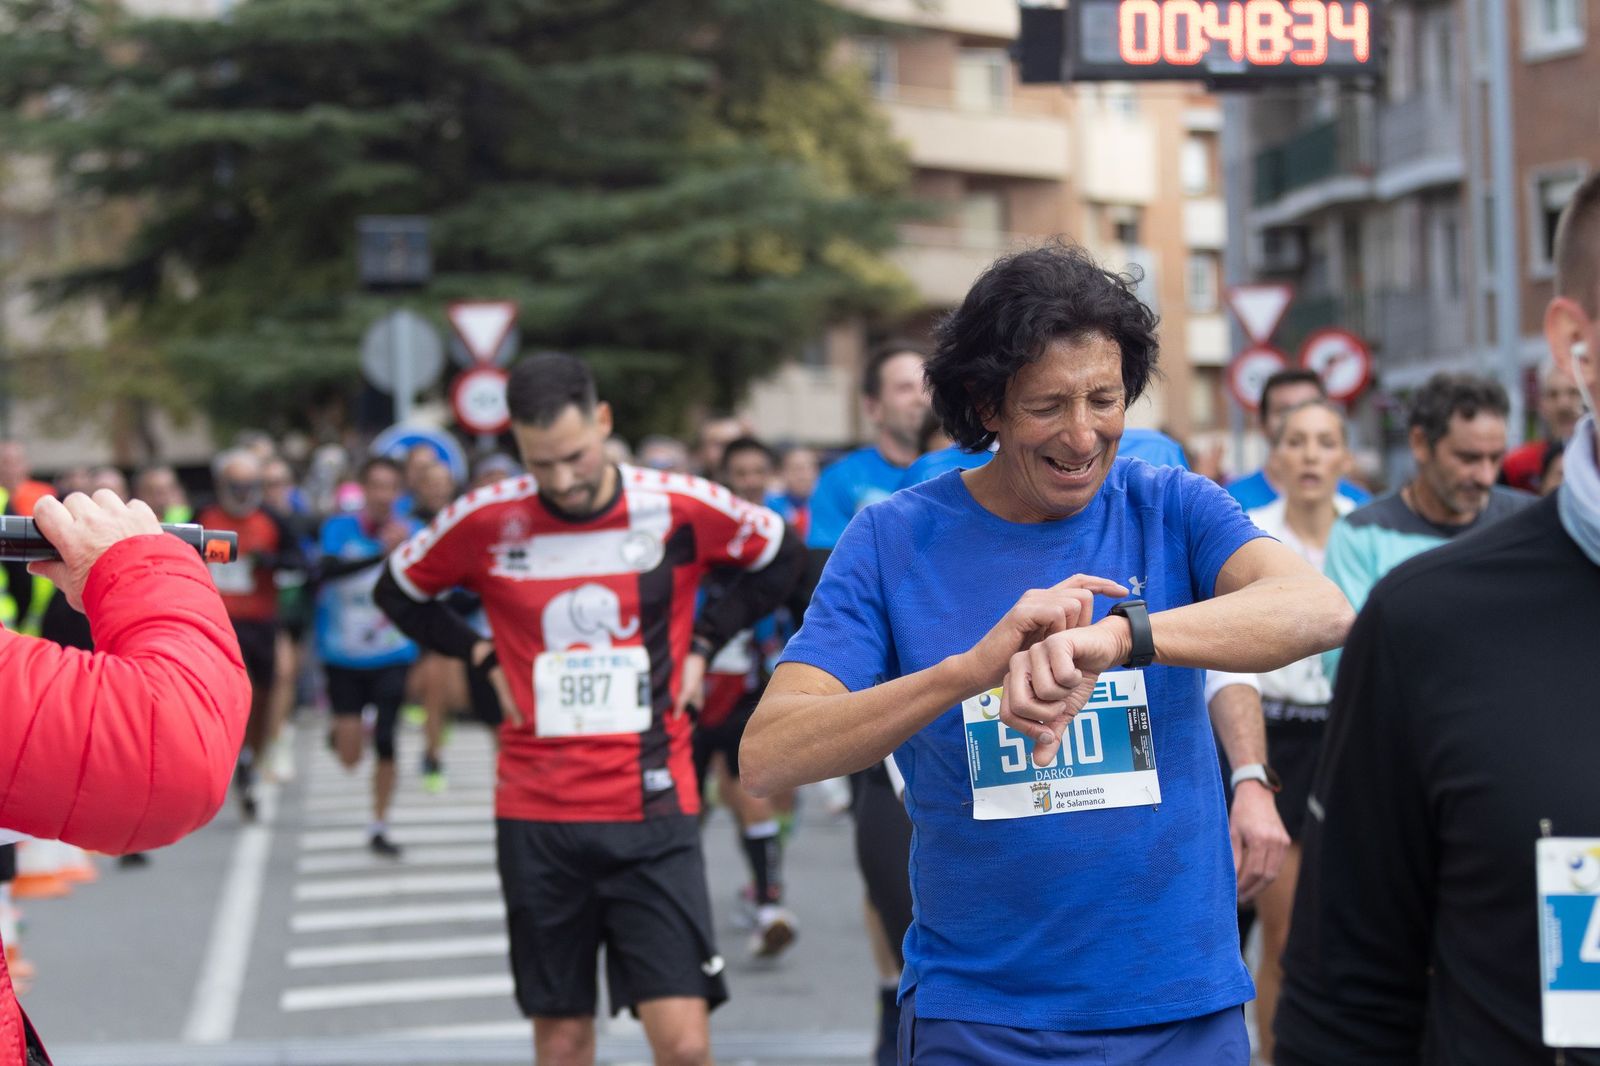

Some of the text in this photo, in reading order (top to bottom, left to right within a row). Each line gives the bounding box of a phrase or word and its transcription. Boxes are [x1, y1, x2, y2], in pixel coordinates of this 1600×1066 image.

[560, 673, 612, 706] 987
[1140, 712, 1148, 730] 5310
[997, 711, 1104, 773] 510
[1035, 767, 1074, 781] DARKO
[1054, 787, 1105, 800] Ayuntamiento
[1056, 798, 1106, 808] de Salamanca
